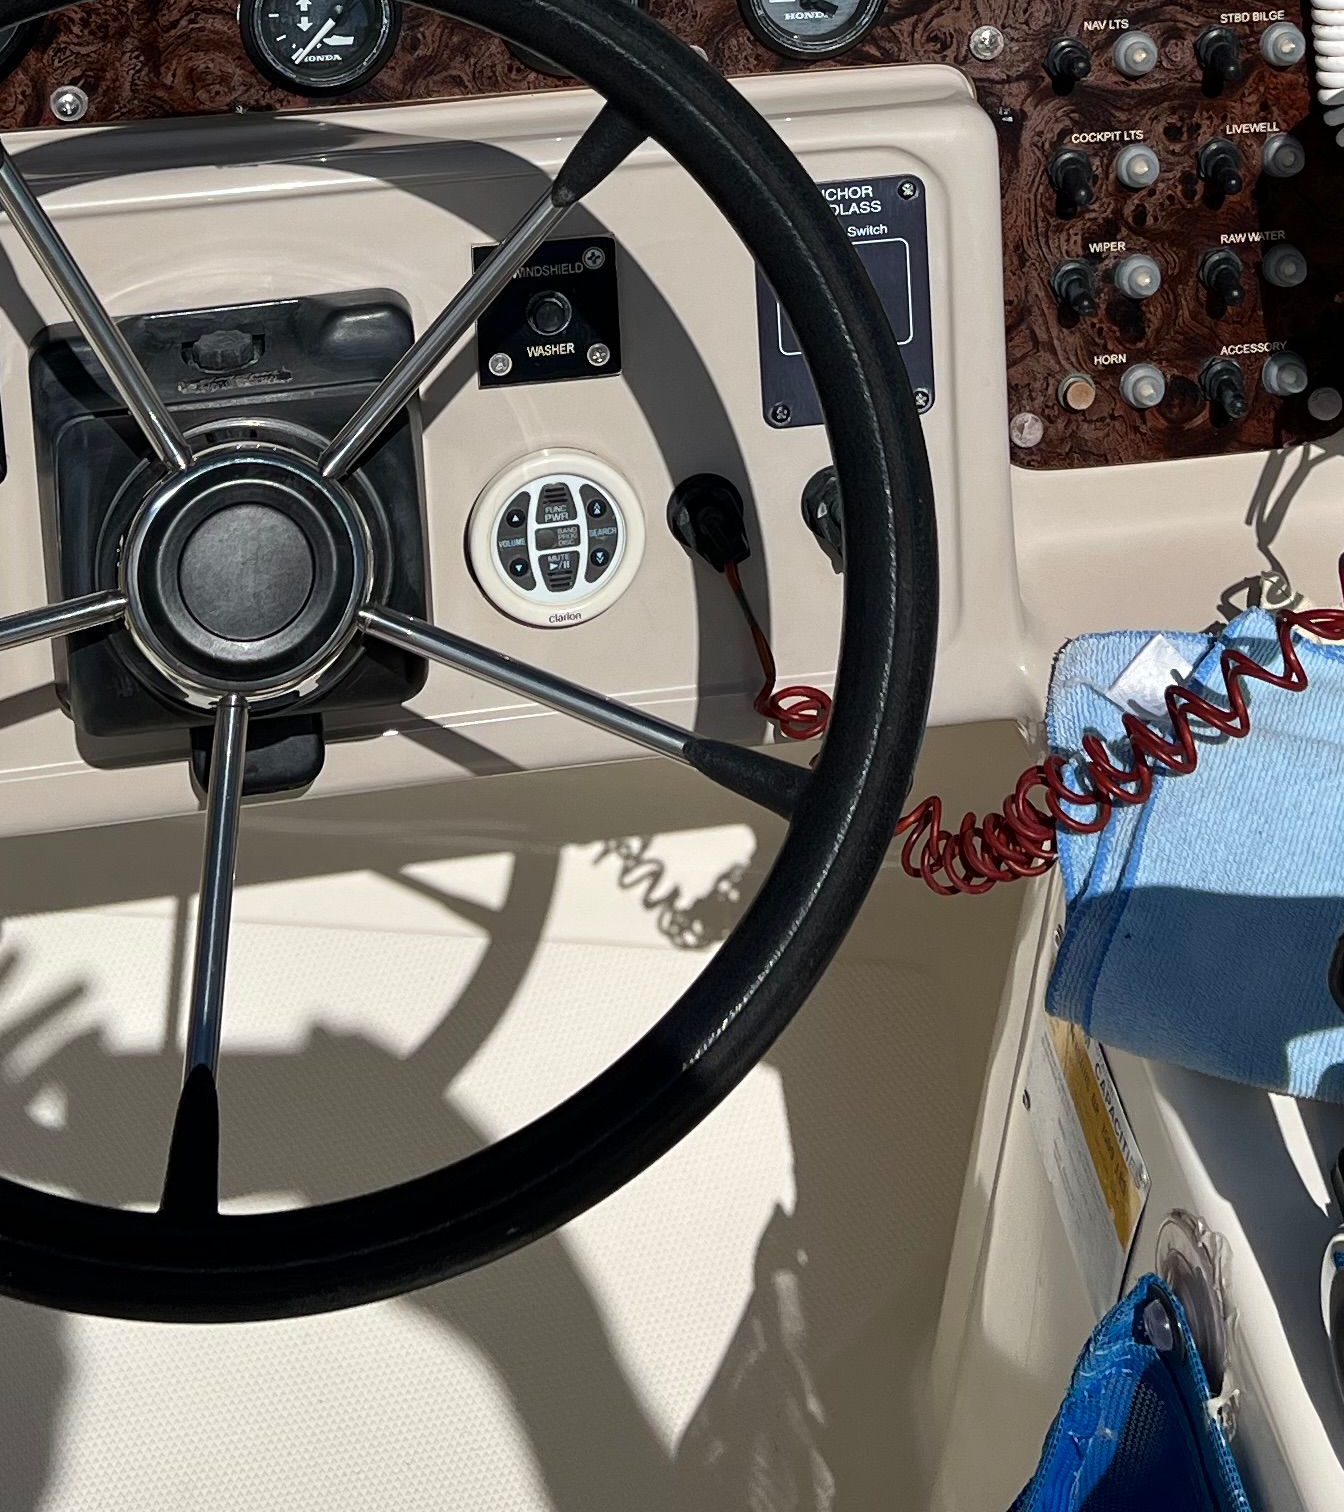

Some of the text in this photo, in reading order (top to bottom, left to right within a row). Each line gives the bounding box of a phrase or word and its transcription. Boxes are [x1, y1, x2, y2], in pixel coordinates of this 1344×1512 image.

[784, 11, 829, 20] HOND
[1220, 10, 1285, 24] STBD BILGE
[1083, 18, 1129, 31] NAV LTS
[304, 54, 342, 63] ONDA
[1226, 122, 1279, 135] LIVEWELL
[1071, 130, 1144, 144] COCKPIT LTS
[822, 186, 873, 201] CHOR
[847, 224, 888, 237] Switch
[1220, 230, 1286, 245] RAW WATER
[1089, 240, 1126, 253] WIPER
[513, 262, 584, 279] WINDSHIELD
[526, 342, 575, 358] WASHER
[1220, 341, 1287, 356] ACCESSORY
[1094, 354, 1127, 366] HORN
[544, 504, 567, 514] FUNC
[544, 512, 569, 523] PWR
[589, 526, 617, 538] SEARCH
[498, 538, 526, 549] VOLUME
[547, 553, 570, 562] MUTE
[548, 611, 582, 624] clarion
